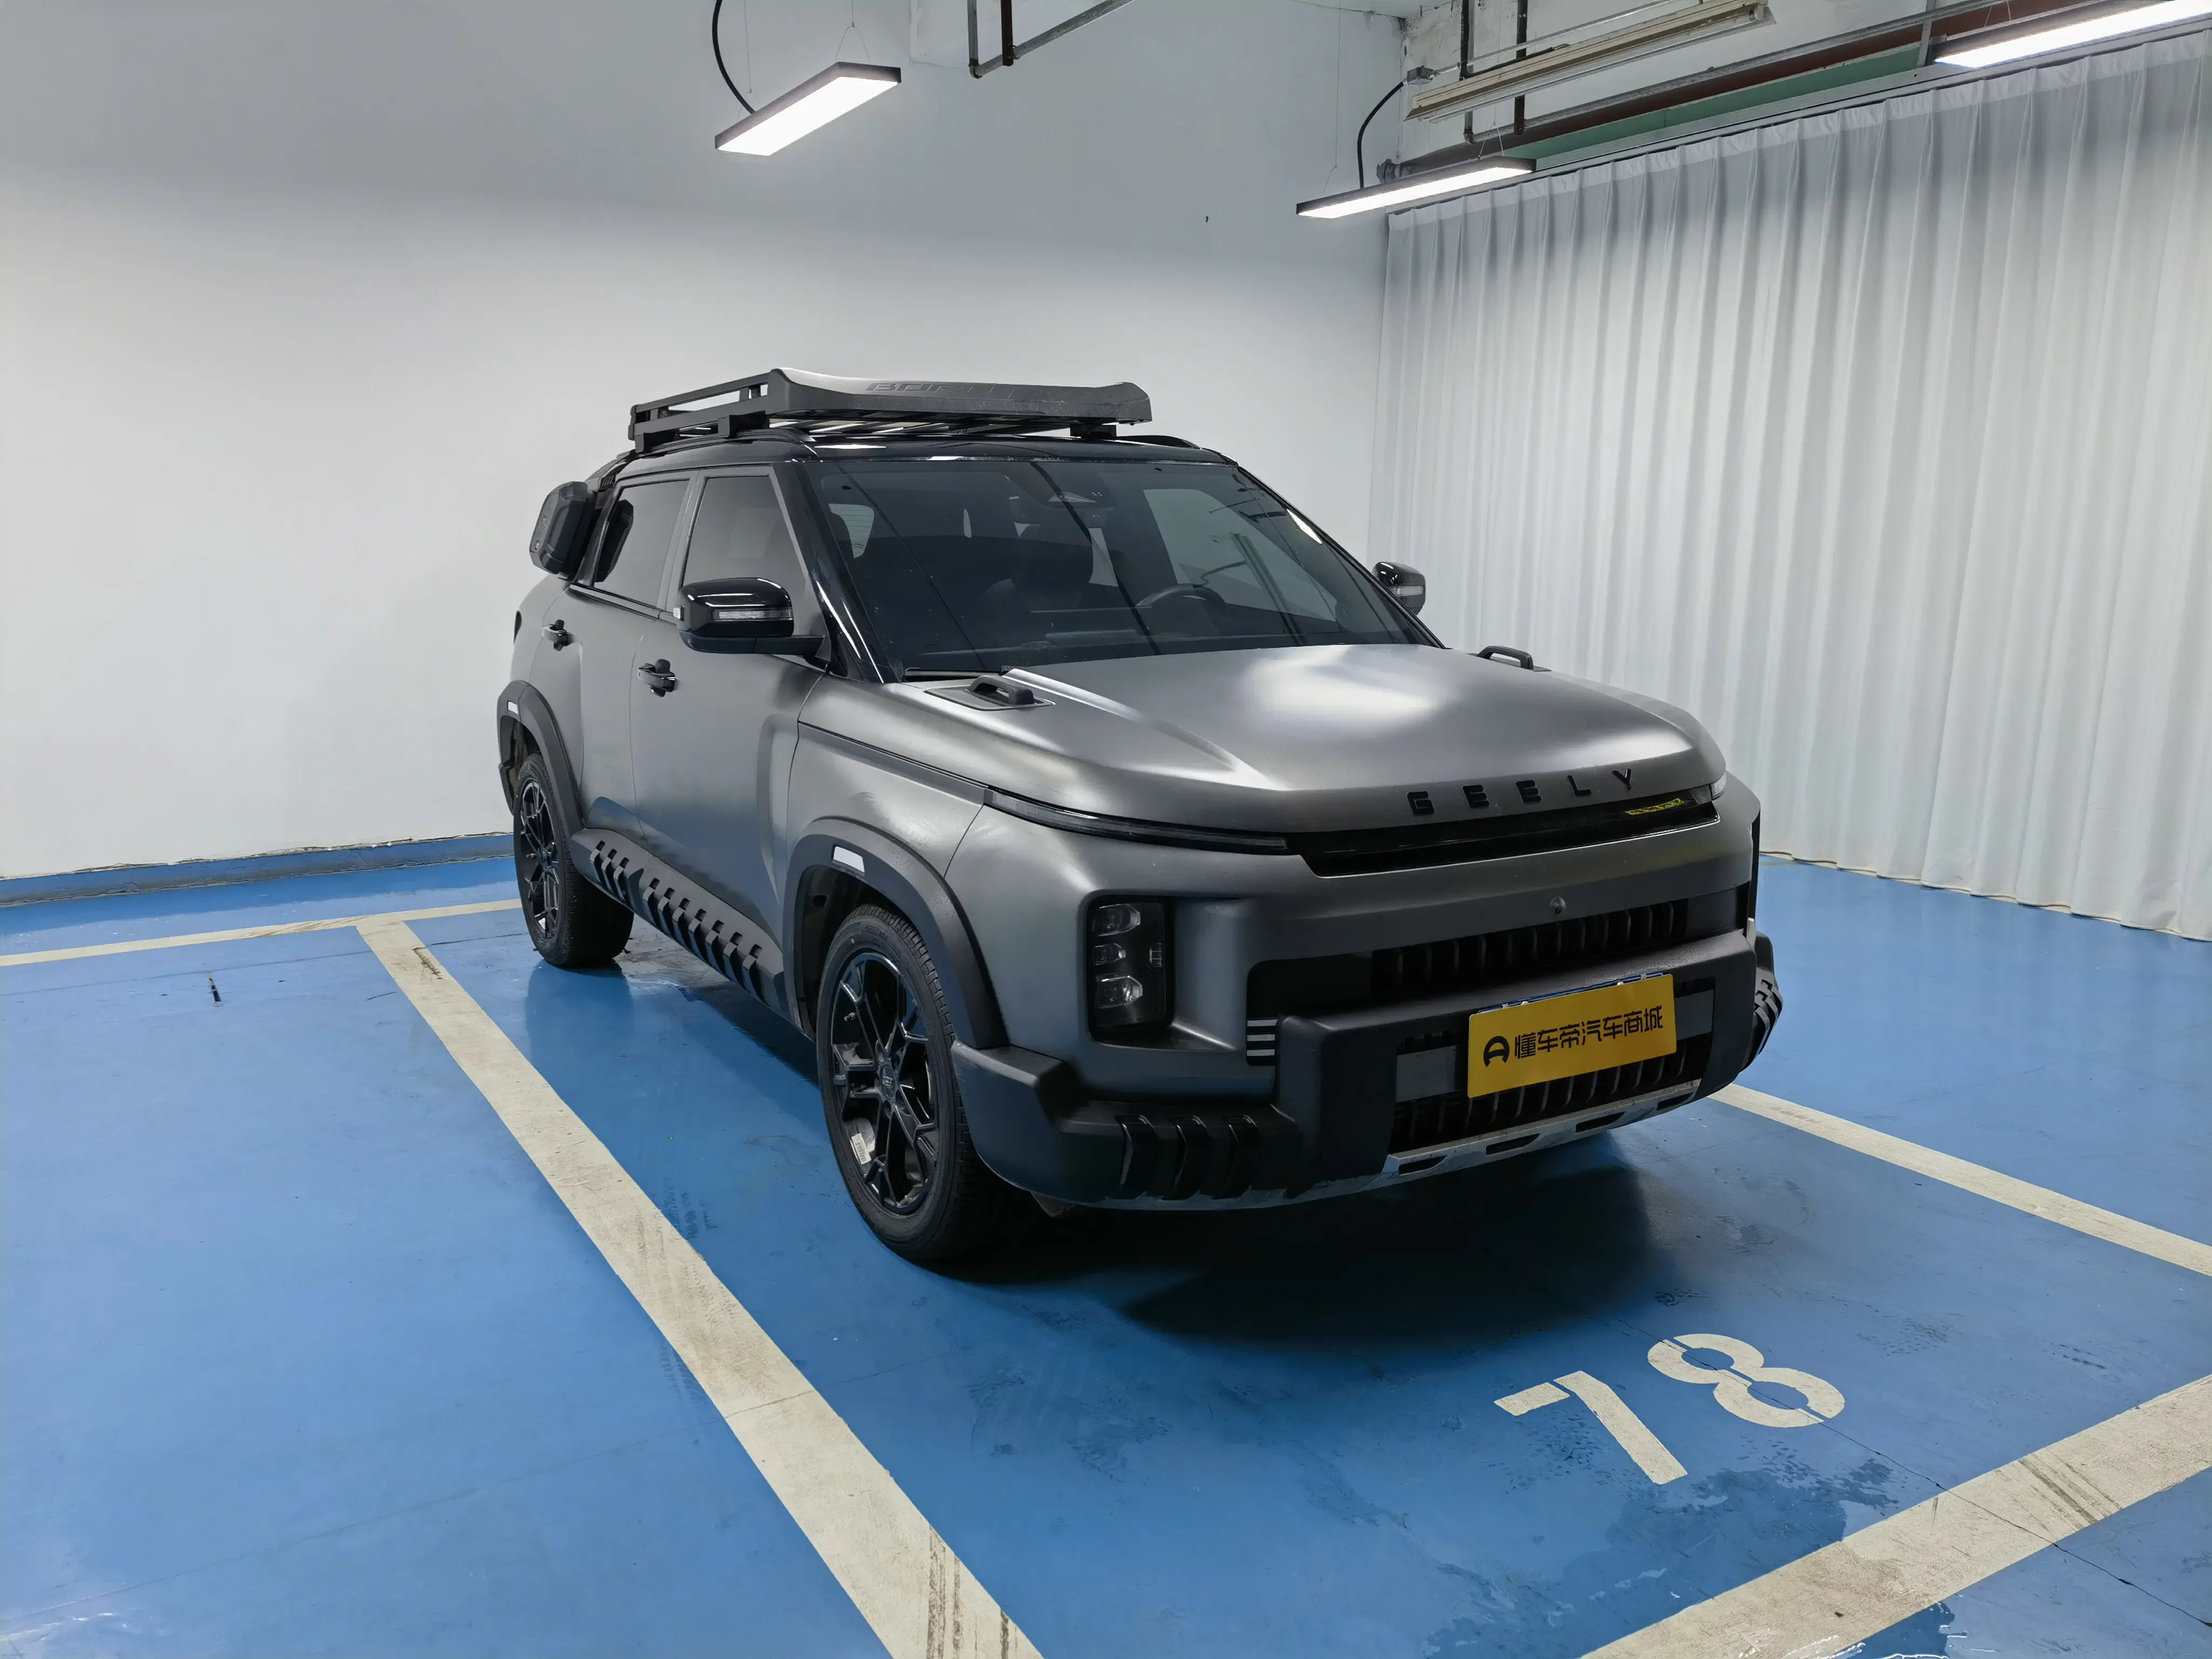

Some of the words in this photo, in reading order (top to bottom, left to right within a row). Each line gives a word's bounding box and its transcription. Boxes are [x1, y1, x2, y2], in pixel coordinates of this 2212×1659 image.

[1406, 767, 1633, 815] GEELY
[1514, 1005, 1663, 1059] 懂车帝汽车商城
[1494, 1333, 1845, 1485] 78
